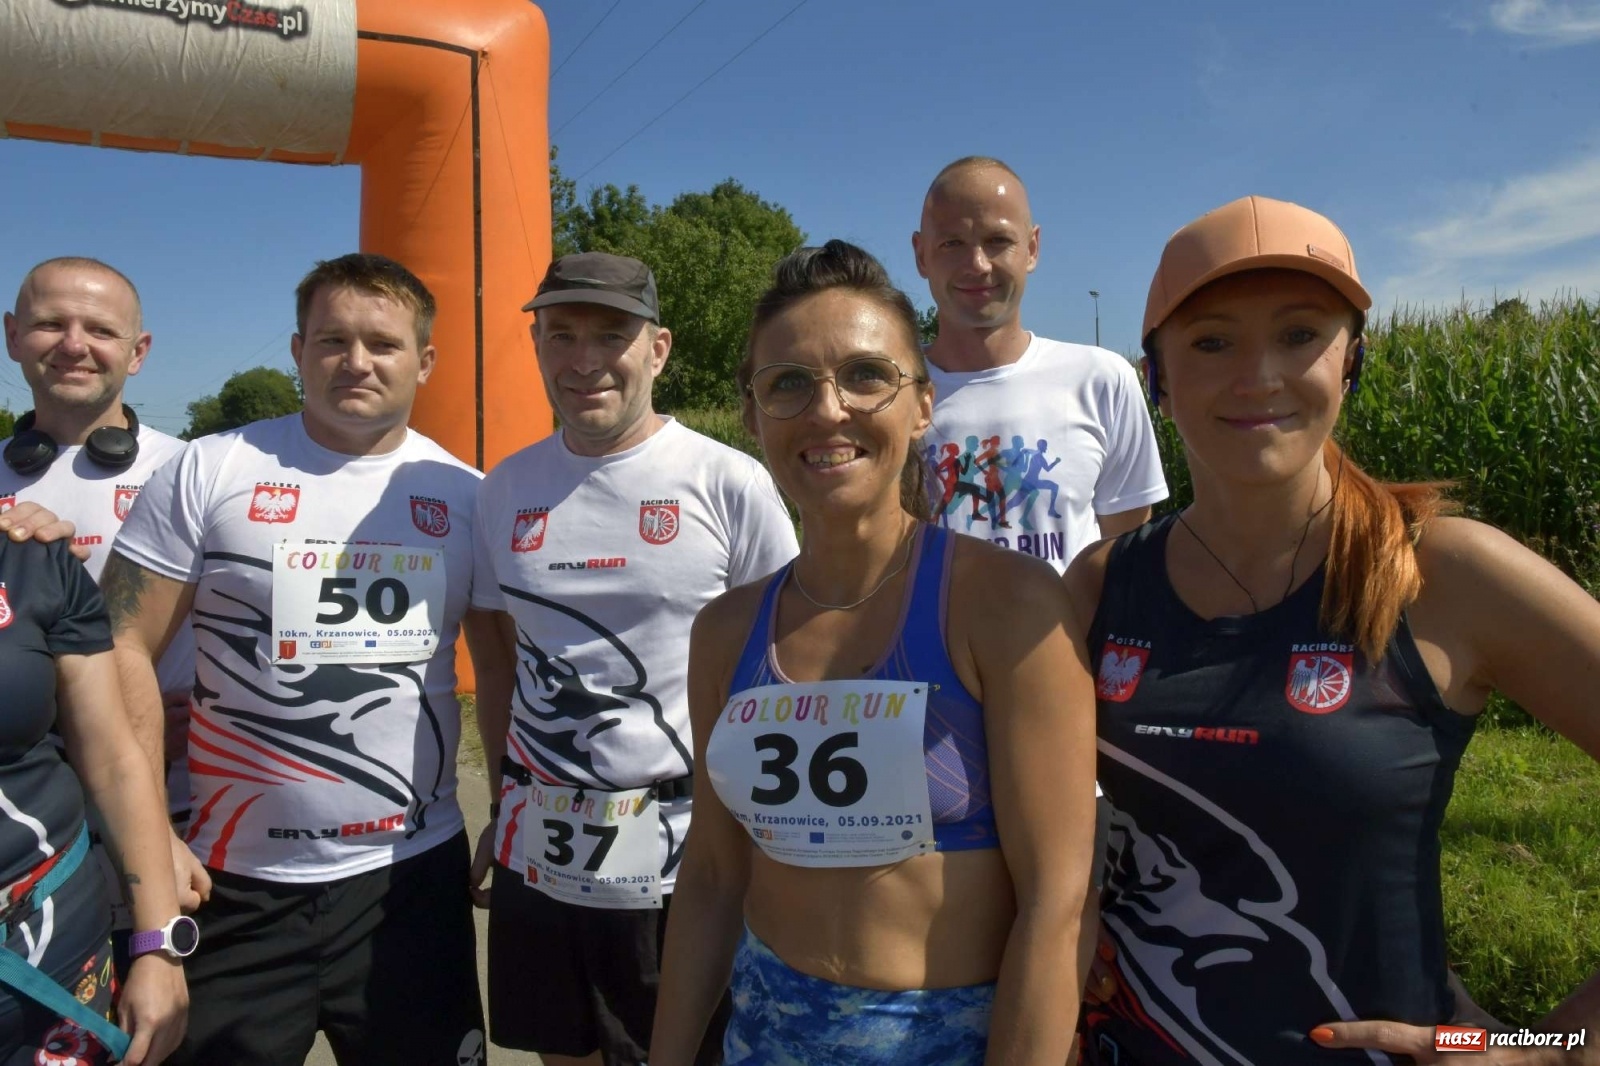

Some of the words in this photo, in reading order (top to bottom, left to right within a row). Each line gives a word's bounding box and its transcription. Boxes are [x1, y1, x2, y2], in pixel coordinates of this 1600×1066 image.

[111, 0, 303, 35] erzymyCzas.pl
[1017, 532, 1064, 560] RUN
[286, 551, 382, 573] COLOUR
[393, 552, 433, 573] RUN
[315, 577, 410, 625] 50
[279, 630, 312, 638] 10km,
[316, 629, 381, 638] Krzanowice,
[387, 629, 437, 637] 05.09.2021
[1107, 633, 1152, 649] POLSKA
[1291, 641, 1355, 652] RACIBÓRZ
[727, 694, 829, 726] COLOUR
[842, 692, 907, 726] RUN
[751, 731, 868, 807] 36
[532, 786, 596, 819] COLOUR
[754, 813, 829, 827] Krzanowice,
[838, 814, 923, 827] 05.09.2021
[543, 819, 619, 872] 37
[599, 875, 656, 884] 05.09.2021
